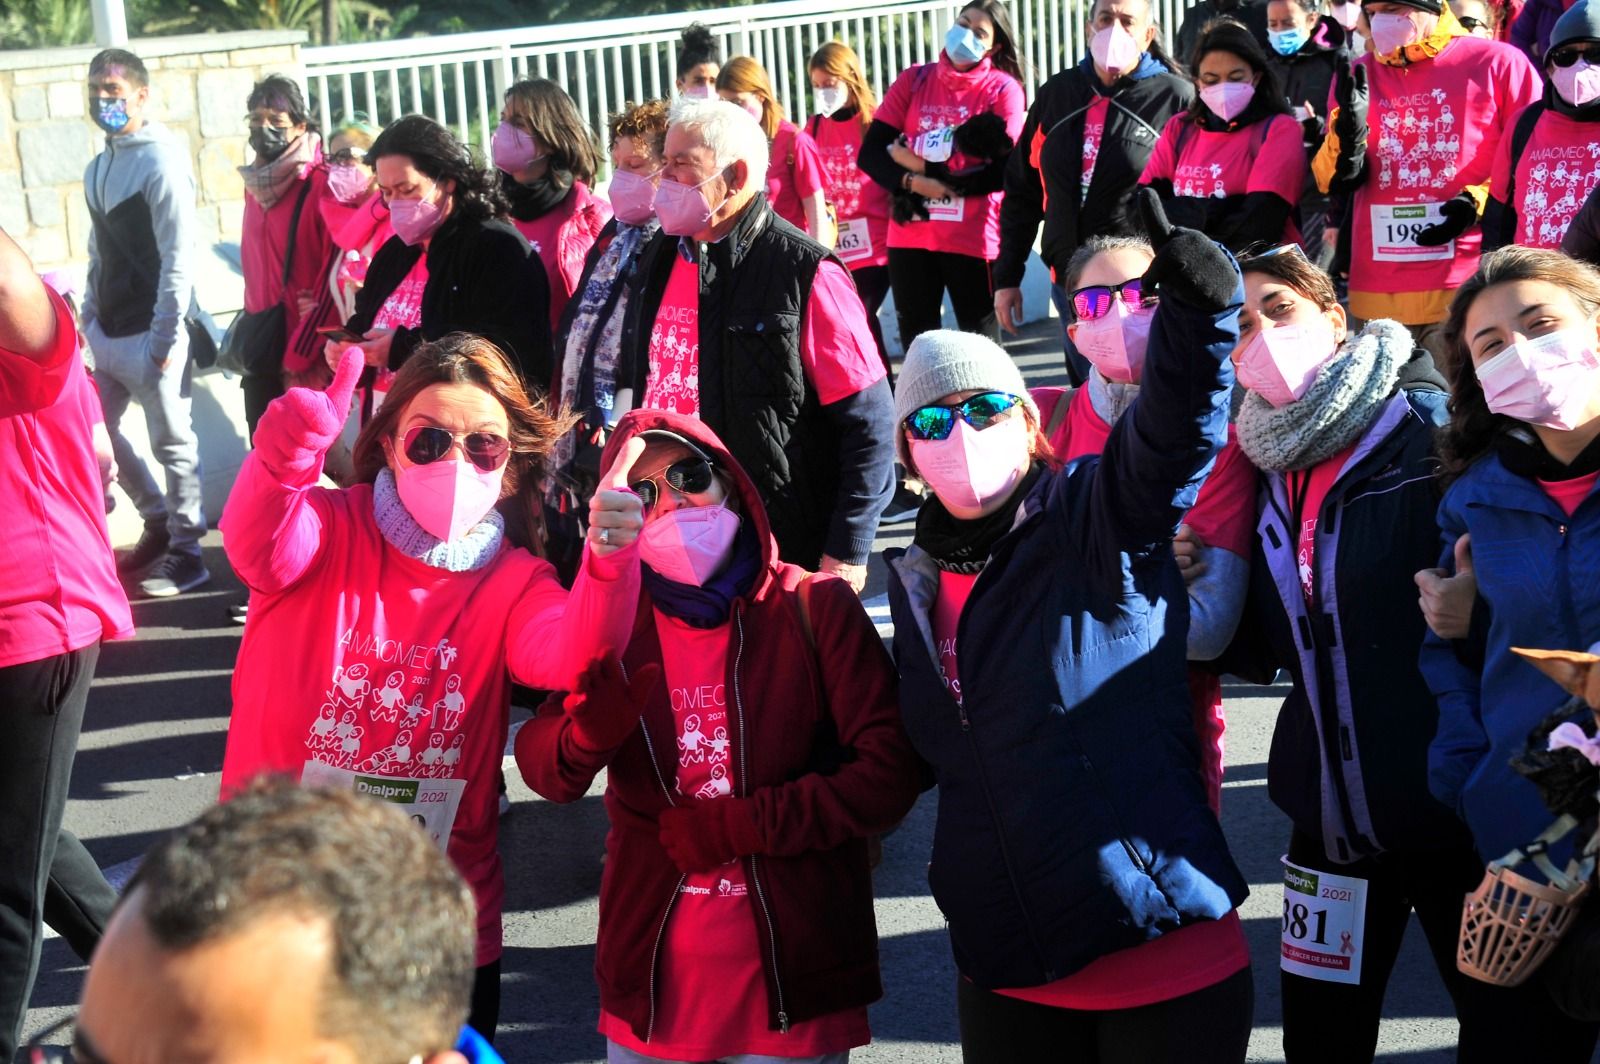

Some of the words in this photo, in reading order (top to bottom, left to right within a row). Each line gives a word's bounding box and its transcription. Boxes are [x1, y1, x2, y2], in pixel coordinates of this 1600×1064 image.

[1528, 146, 1586, 161] AMACMEC
[338, 628, 438, 671] AMACMEC
[411, 675, 431, 685] 2021
[670, 684, 726, 712] CMEC
[707, 711, 726, 721] 2021
[357, 781, 414, 798] Dialprix
[420, 792, 448, 803] 2021
[1322, 887, 1351, 902] 2021
